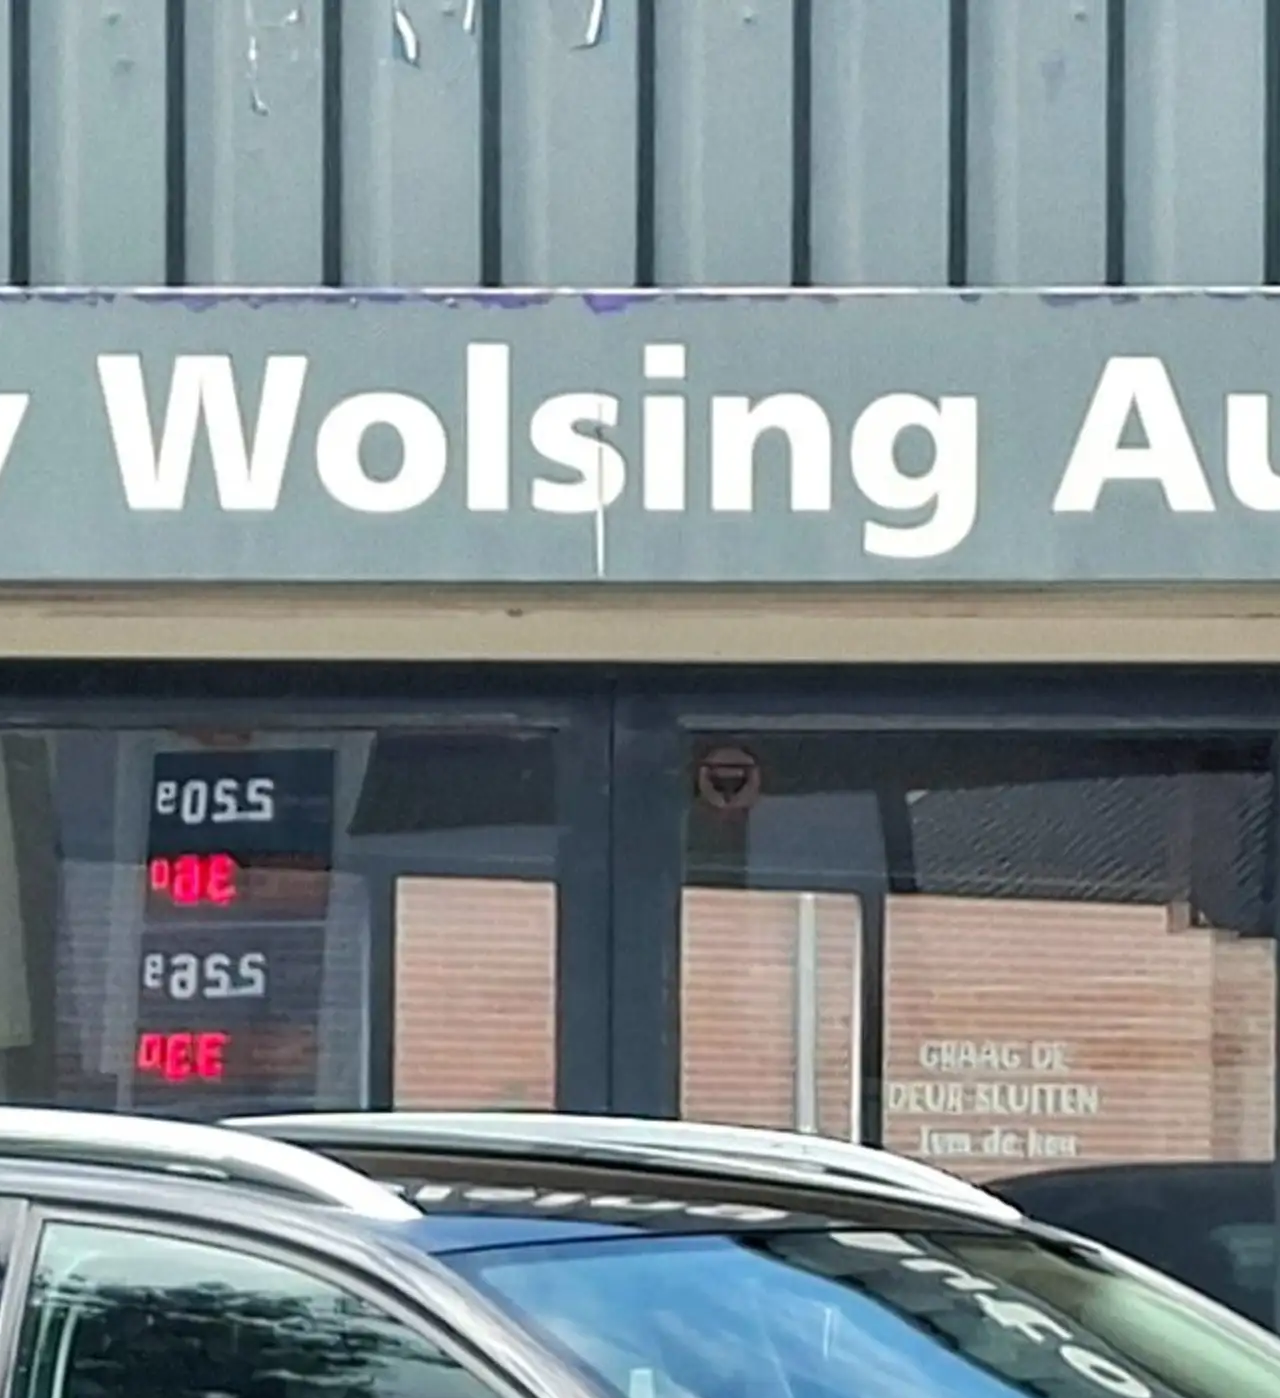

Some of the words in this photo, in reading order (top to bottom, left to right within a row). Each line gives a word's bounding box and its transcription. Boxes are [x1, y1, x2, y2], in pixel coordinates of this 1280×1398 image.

[96, 343, 979, 559] Wolsing
[921, 1039, 1021, 1072] GRAAG
[1031, 1040, 1071, 1073] DE
[887, 1082, 964, 1115] DEUR
[975, 1083, 1099, 1115] SLUITEN
